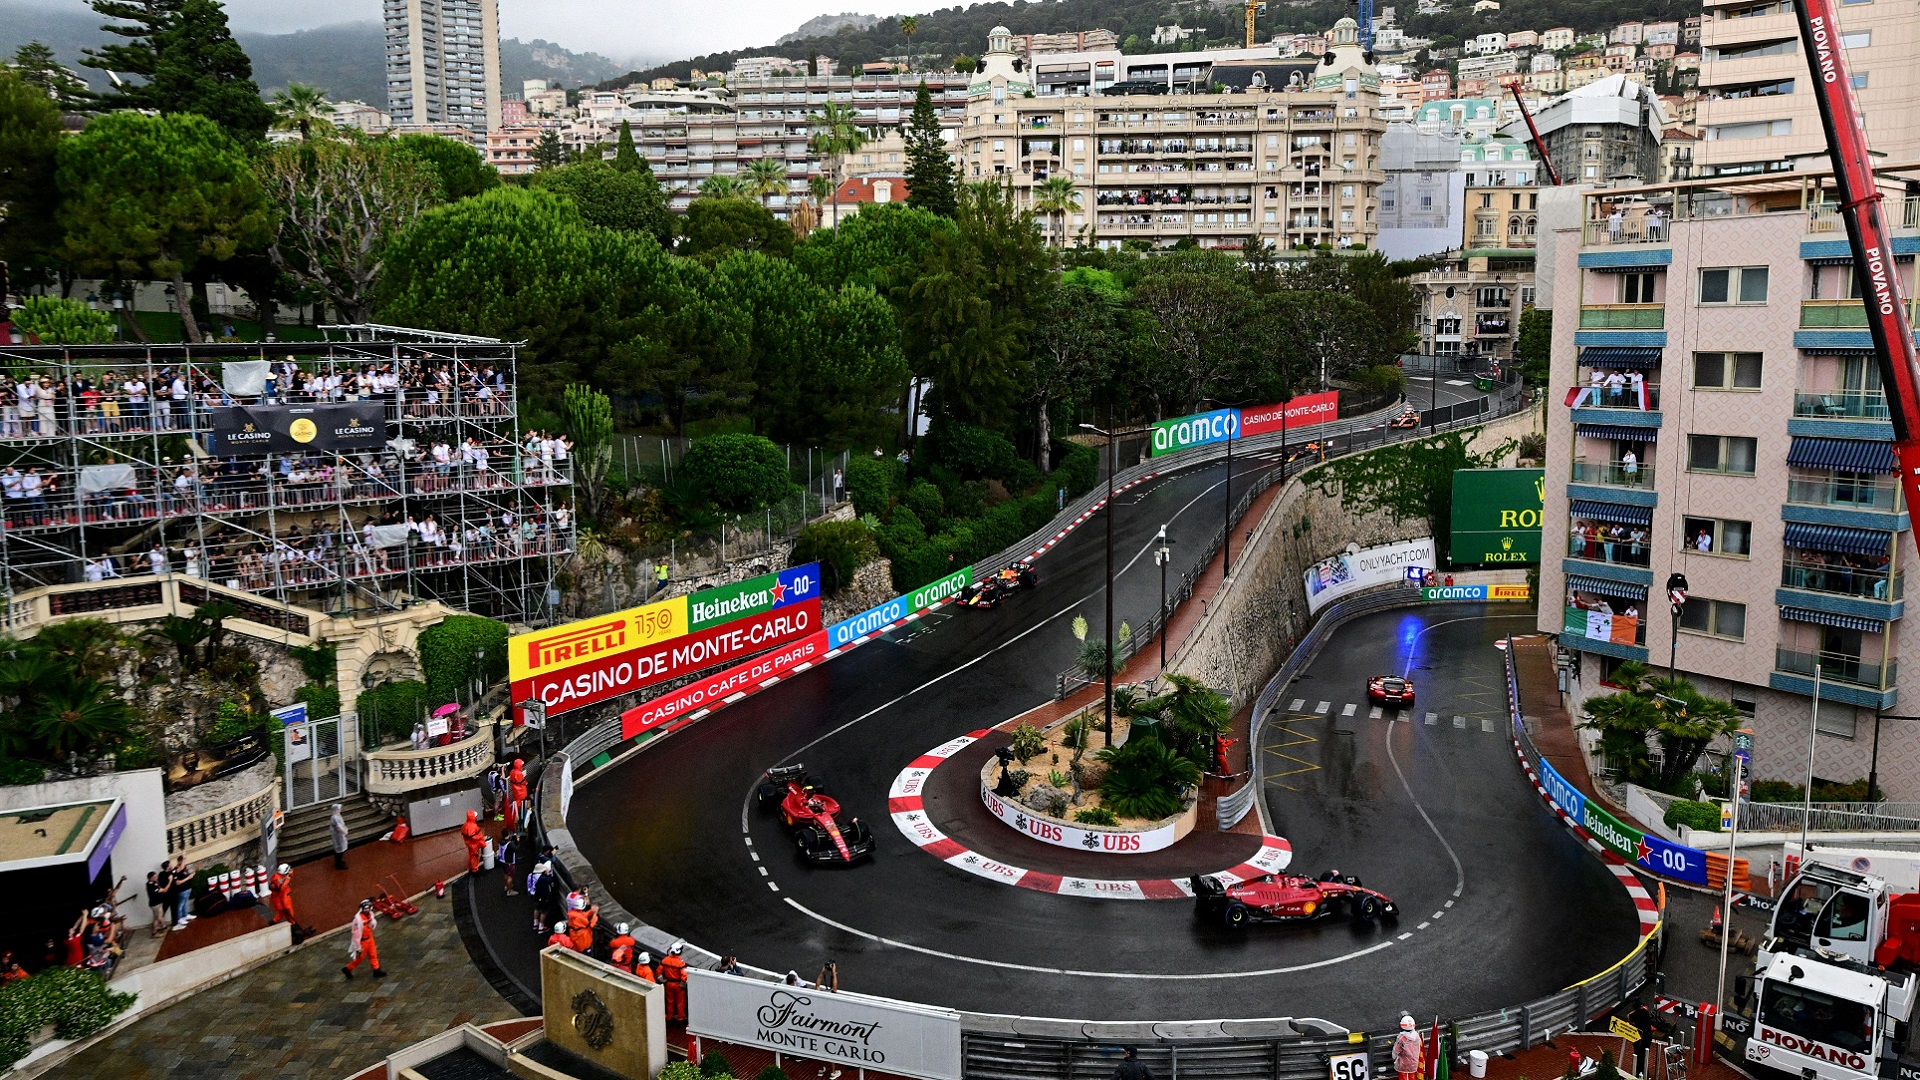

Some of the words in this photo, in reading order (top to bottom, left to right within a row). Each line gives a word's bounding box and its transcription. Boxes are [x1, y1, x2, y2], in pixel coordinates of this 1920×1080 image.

[1810, 16, 1837, 83] PIOVANO
[1866, 247, 1893, 315] PIOVANO
[1243, 413, 1272, 425] CASINO
[1272, 410, 1283, 420] DE
[1284, 402, 1335, 418] MONTE-CARLO
[237, 432, 271, 440] CASINO
[1154, 412, 1237, 450] aramco
[1360, 548, 1430, 572] ONLYYACHT.COM
[1485, 552, 1527, 562] ROLEX
[915, 574, 966, 608] aramco
[1428, 587, 1481, 599] aramco
[692, 588, 768, 624] Heineken
[635, 609, 672, 638] 150
[837, 602, 900, 643] aramco
[528, 619, 626, 669] PIRELLI
[541, 661, 632, 707] CASINO
[638, 651, 664, 680] DE
[672, 610, 808, 667] MONTE-CARLO
[641, 691, 704, 725] CASINO
[707, 671, 748, 696] CAFE
[751, 663, 772, 678] DE
[775, 643, 815, 668] PARIS
[936, 744, 960, 756] UBS
[903, 779, 920, 793] UBS
[1543, 767, 1578, 818] aramco
[987, 793, 1004, 817] UBS
[914, 822, 937, 839] UBS
[1029, 819, 1062, 842] UBS
[1103, 835, 1140, 850] UBS
[1583, 807, 1632, 854] Heineken
[982, 861, 1007, 877] UBS
[1095, 882, 1132, 892] UBS
[757, 991, 882, 1045] Fairmont
[757, 1028, 818, 1052] MONTE
[824, 1041, 885, 1064] CARLO
[1761, 1028, 1866, 1070] PIOVANO
[1336, 1059, 1365, 1080] SC
